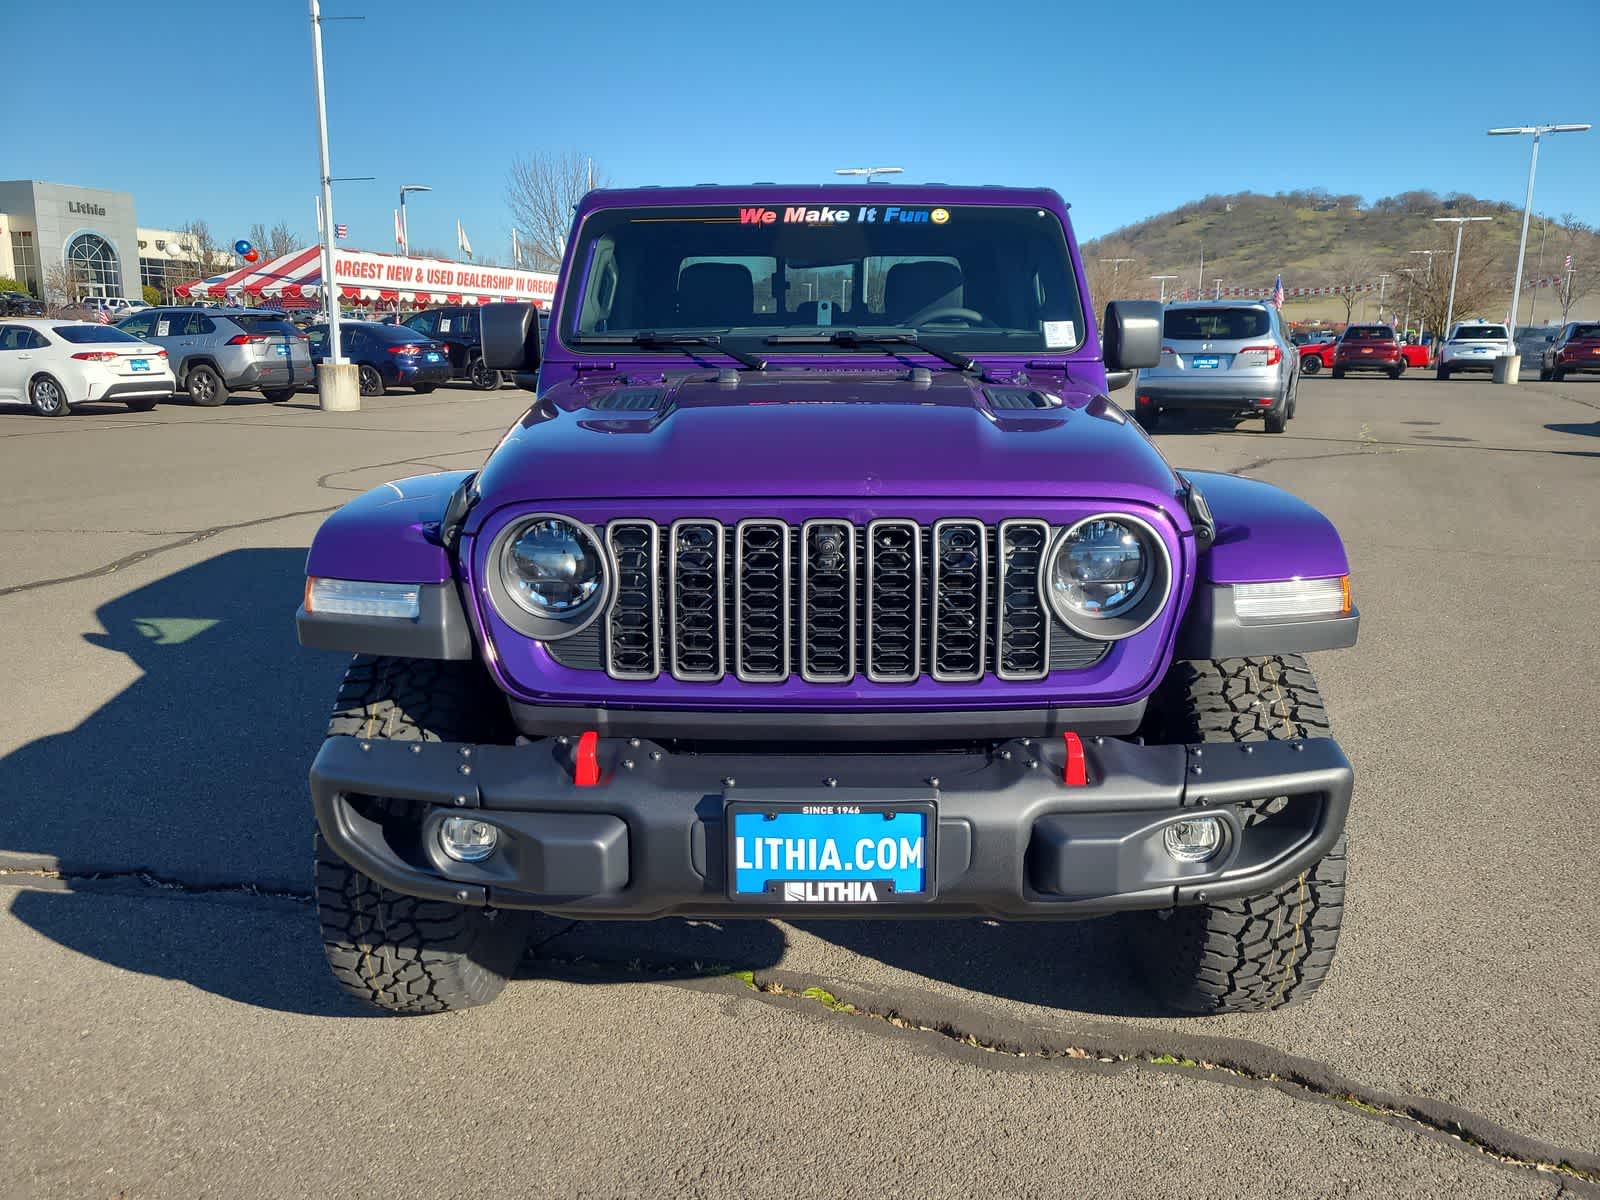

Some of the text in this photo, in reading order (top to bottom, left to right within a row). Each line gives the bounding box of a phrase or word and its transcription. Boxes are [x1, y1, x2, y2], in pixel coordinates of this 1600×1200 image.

[68, 201, 106, 217] Lithia
[739, 207, 929, 224] We Make It Fun
[335, 259, 384, 280] ARGEST
[387, 264, 413, 282] NEW
[415, 267, 424, 284] &
[427, 268, 454, 286] USED
[456, 271, 514, 291] DEALERSHIP
[515, 277, 525, 292] IN
[802, 806, 861, 815] SINCE 1946
[735, 836, 925, 871] LITHIA.COM
[805, 882, 878, 902] LITHIA
